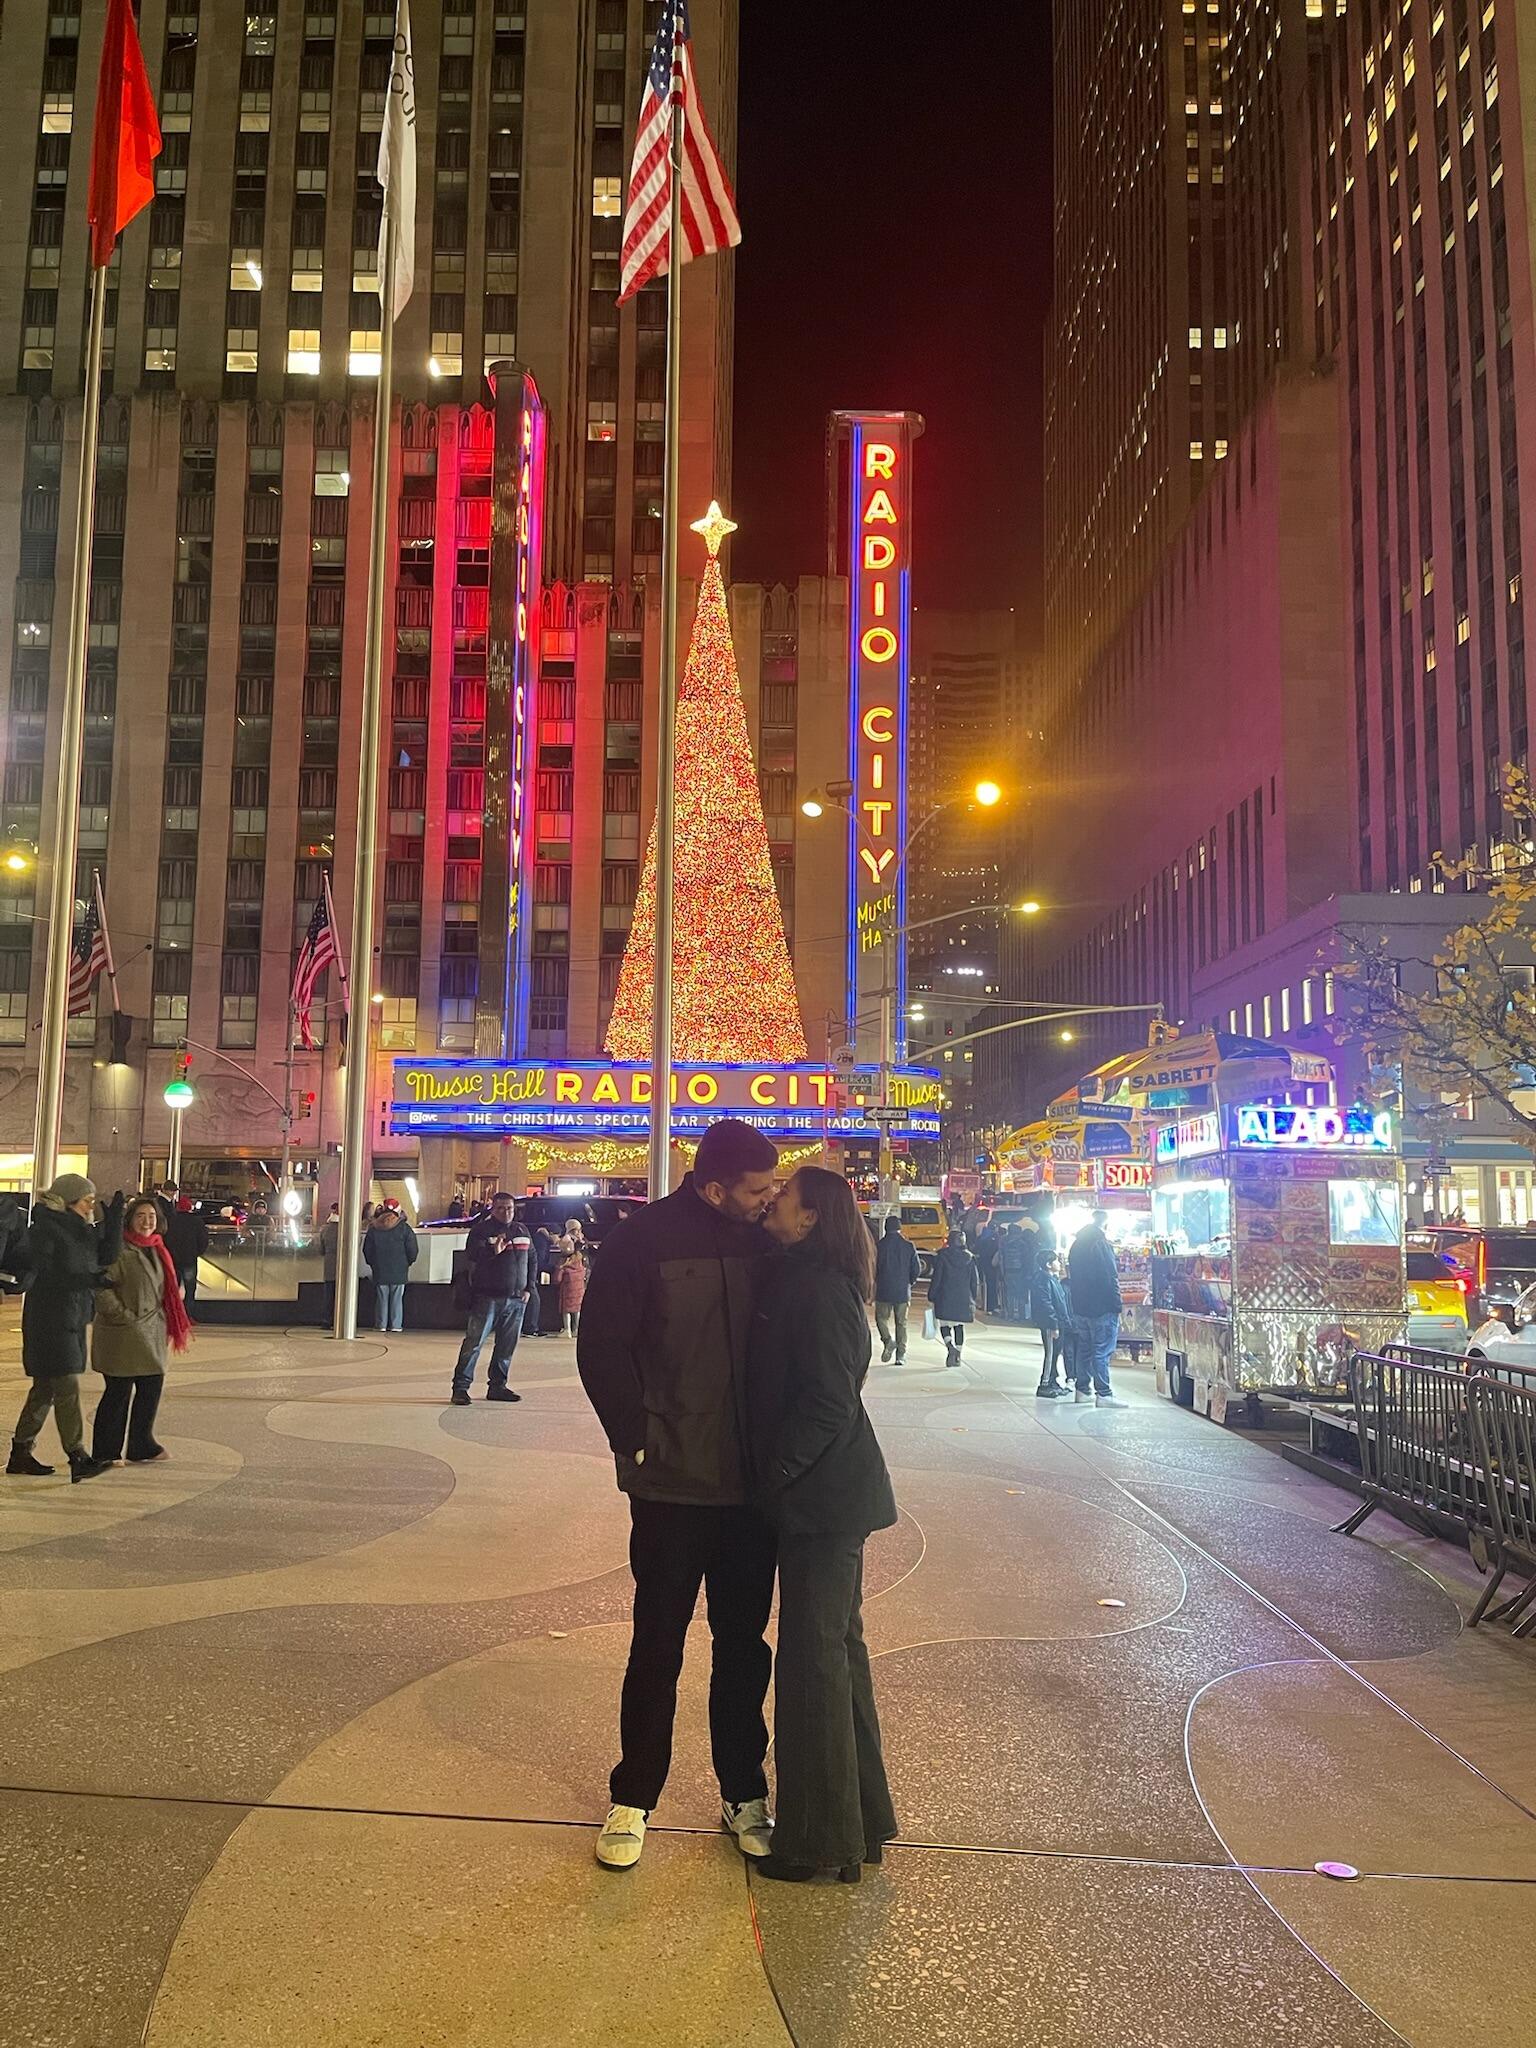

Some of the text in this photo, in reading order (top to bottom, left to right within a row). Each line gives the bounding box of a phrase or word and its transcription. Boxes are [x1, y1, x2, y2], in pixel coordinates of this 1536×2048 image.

[859, 443, 898, 884] RADIO CITY
[406, 1069, 866, 1106] Music Hall RADIO CIT
[1131, 1064, 1216, 1089] SABRETT
[467, 1113, 492, 1124] THE
[503, 1114, 583, 1126] CHRISTMAS
[595, 1114, 698, 1127] SPECTALAR
[708, 1116, 776, 1128] SRING
[787, 1117, 812, 1128] THE
